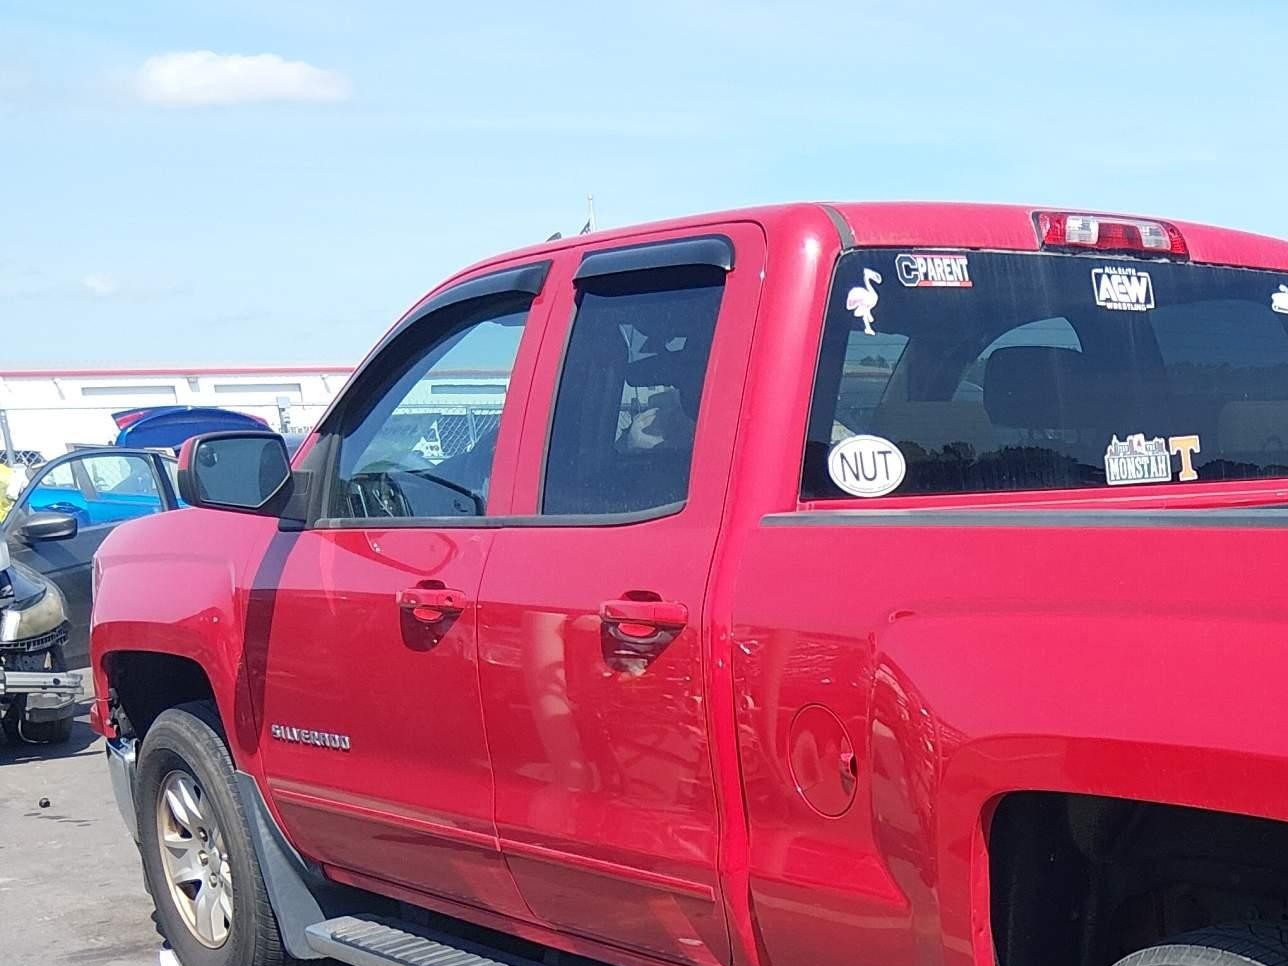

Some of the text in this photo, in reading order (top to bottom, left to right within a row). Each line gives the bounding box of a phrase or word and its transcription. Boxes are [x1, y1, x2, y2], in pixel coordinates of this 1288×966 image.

[917, 257, 970, 282] PARENT
[1099, 274, 1148, 304] AEW
[1106, 302, 1147, 311] WRESTLING
[840, 450, 892, 482] NUT
[1108, 455, 1167, 481] MONSTAH
[1168, 435, 1200, 481] T
[271, 724, 351, 750] SILVERADO
